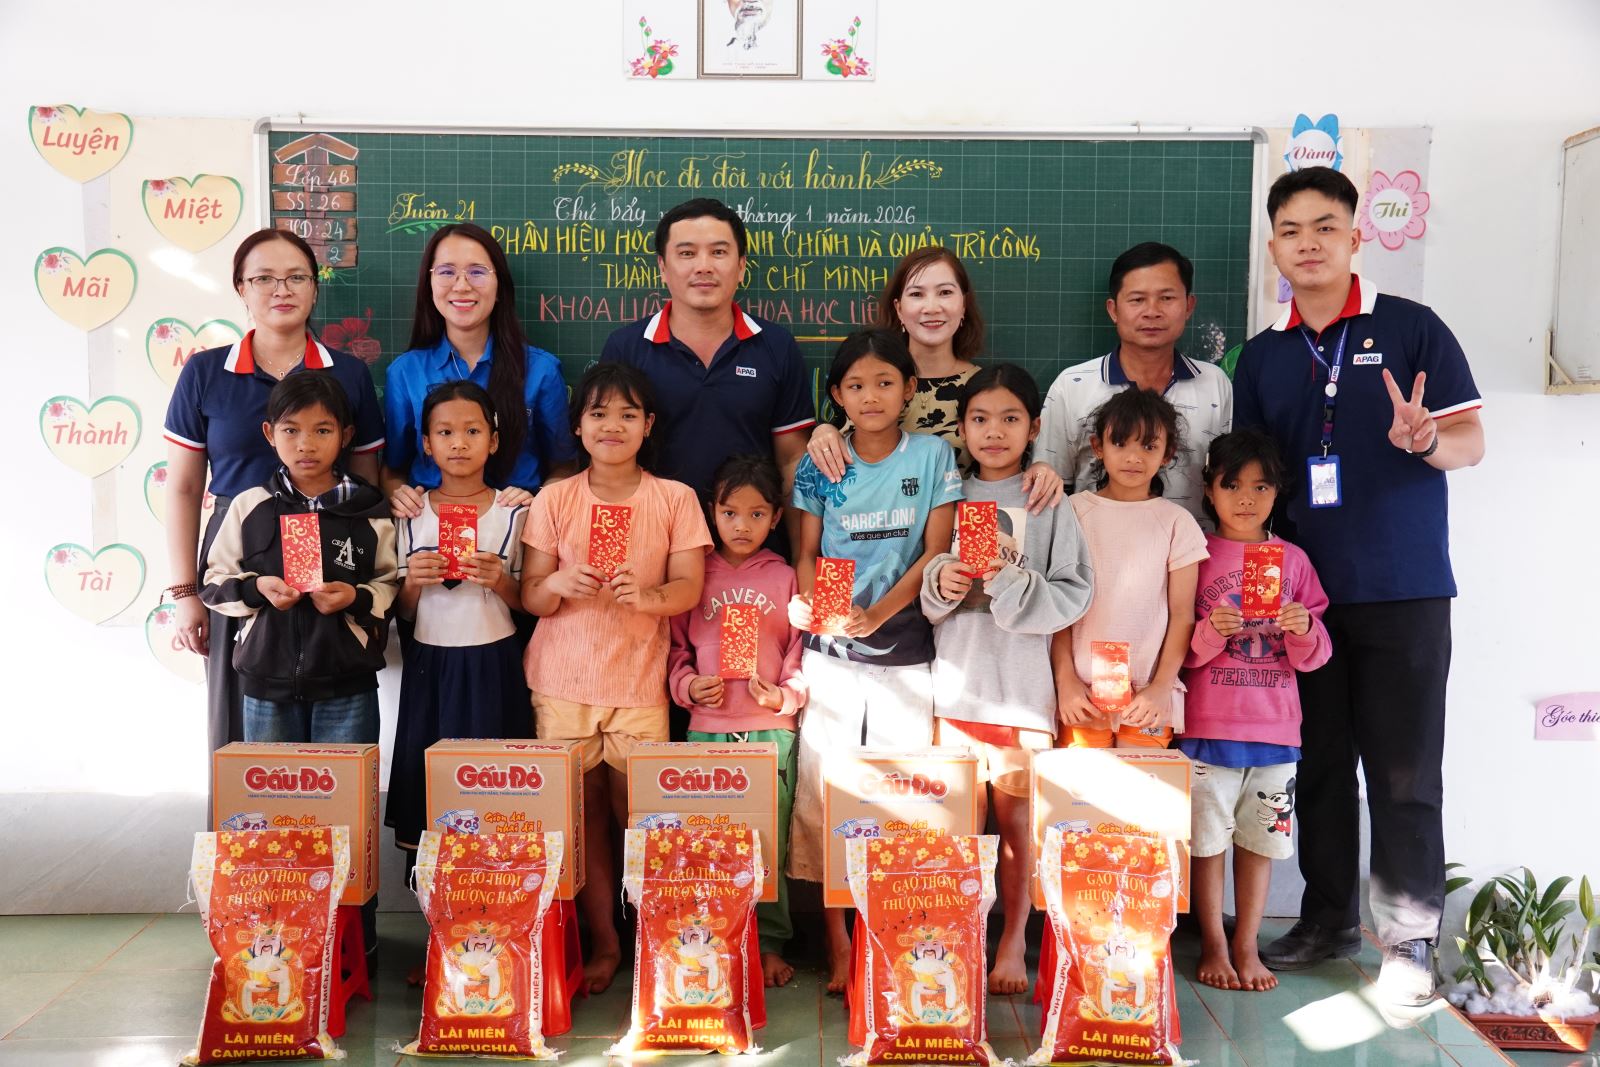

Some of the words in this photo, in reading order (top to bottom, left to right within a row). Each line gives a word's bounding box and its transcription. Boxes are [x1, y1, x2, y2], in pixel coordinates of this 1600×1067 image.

[42, 126, 119, 156] Luyện
[1293, 145, 1336, 162] Vàng
[328, 170, 350, 186] 4B
[678, 154, 710, 188] đi
[712, 151, 750, 188] đôi
[758, 161, 794, 190] với
[804, 148, 875, 190] hành
[163, 198, 223, 224] Miệt
[317, 195, 341, 211] 26
[454, 199, 476, 222] 21
[1372, 201, 1410, 219] Thi
[553, 196, 597, 221] Thứ
[736, 197, 797, 238] tháng
[806, 205, 813, 222] 1
[826, 205, 872, 225] năm
[874, 205, 916, 225] 2026
[321, 221, 343, 240] 24
[491, 220, 549, 255] PHÂN
[783, 227, 849, 258] CHÍNH
[858, 229, 883, 257] VÀ
[889, 225, 944, 257] QUẢN
[950, 230, 986, 264] TRỊ
[767, 261, 814, 292] CHÍ
[824, 265, 889, 293] MINH
[62, 276, 109, 298] Mãi
[540, 293, 612, 323] KHOA
[800, 296, 844, 335] HỌC
[1355, 355, 1380, 363] APAG
[736, 367, 756, 376] APAG
[52, 422, 128, 446] Thành
[841, 507, 916, 530] BARCELONA
[867, 532, 882, 541] que
[893, 529, 910, 537] club
[78, 571, 113, 593] Tài
[703, 587, 777, 621] CALVERT
[1542, 704, 1577, 727] Góc
[246, 766, 299, 791] Gấu
[299, 767, 335, 793] Đỏ
[456, 765, 506, 788] Gấu
[508, 765, 543, 790] Đỏ
[659, 767, 711, 792] Gấu
[712, 767, 749, 792] Đỏ
[509, 811, 526, 822] dai
[713, 814, 729, 825] dai
[658, 1015, 682, 1029] LÀI
[686, 1015, 725, 1029] MIÊN
[224, 1032, 249, 1045] LÀI
[254, 1032, 295, 1045] MIÊN
[439, 1026, 463, 1039] LÀI
[467, 1026, 506, 1039] MIÊN
[646, 1034, 736, 1045] CAMPUCHIA
[1082, 1030, 1107, 1043] LÀI
[1112, 1033, 1151, 1048] MIÊN
[428, 1044, 519, 1053] CAMPUCHIA
[896, 1036, 921, 1049] LÀI
[925, 1036, 965, 1049] MIÊN
[212, 1047, 308, 1058] CAMPUCHIA
[883, 1052, 976, 1061] CAMPUCHIA
[1068, 1045, 1161, 1061] CAMPUCHIA
